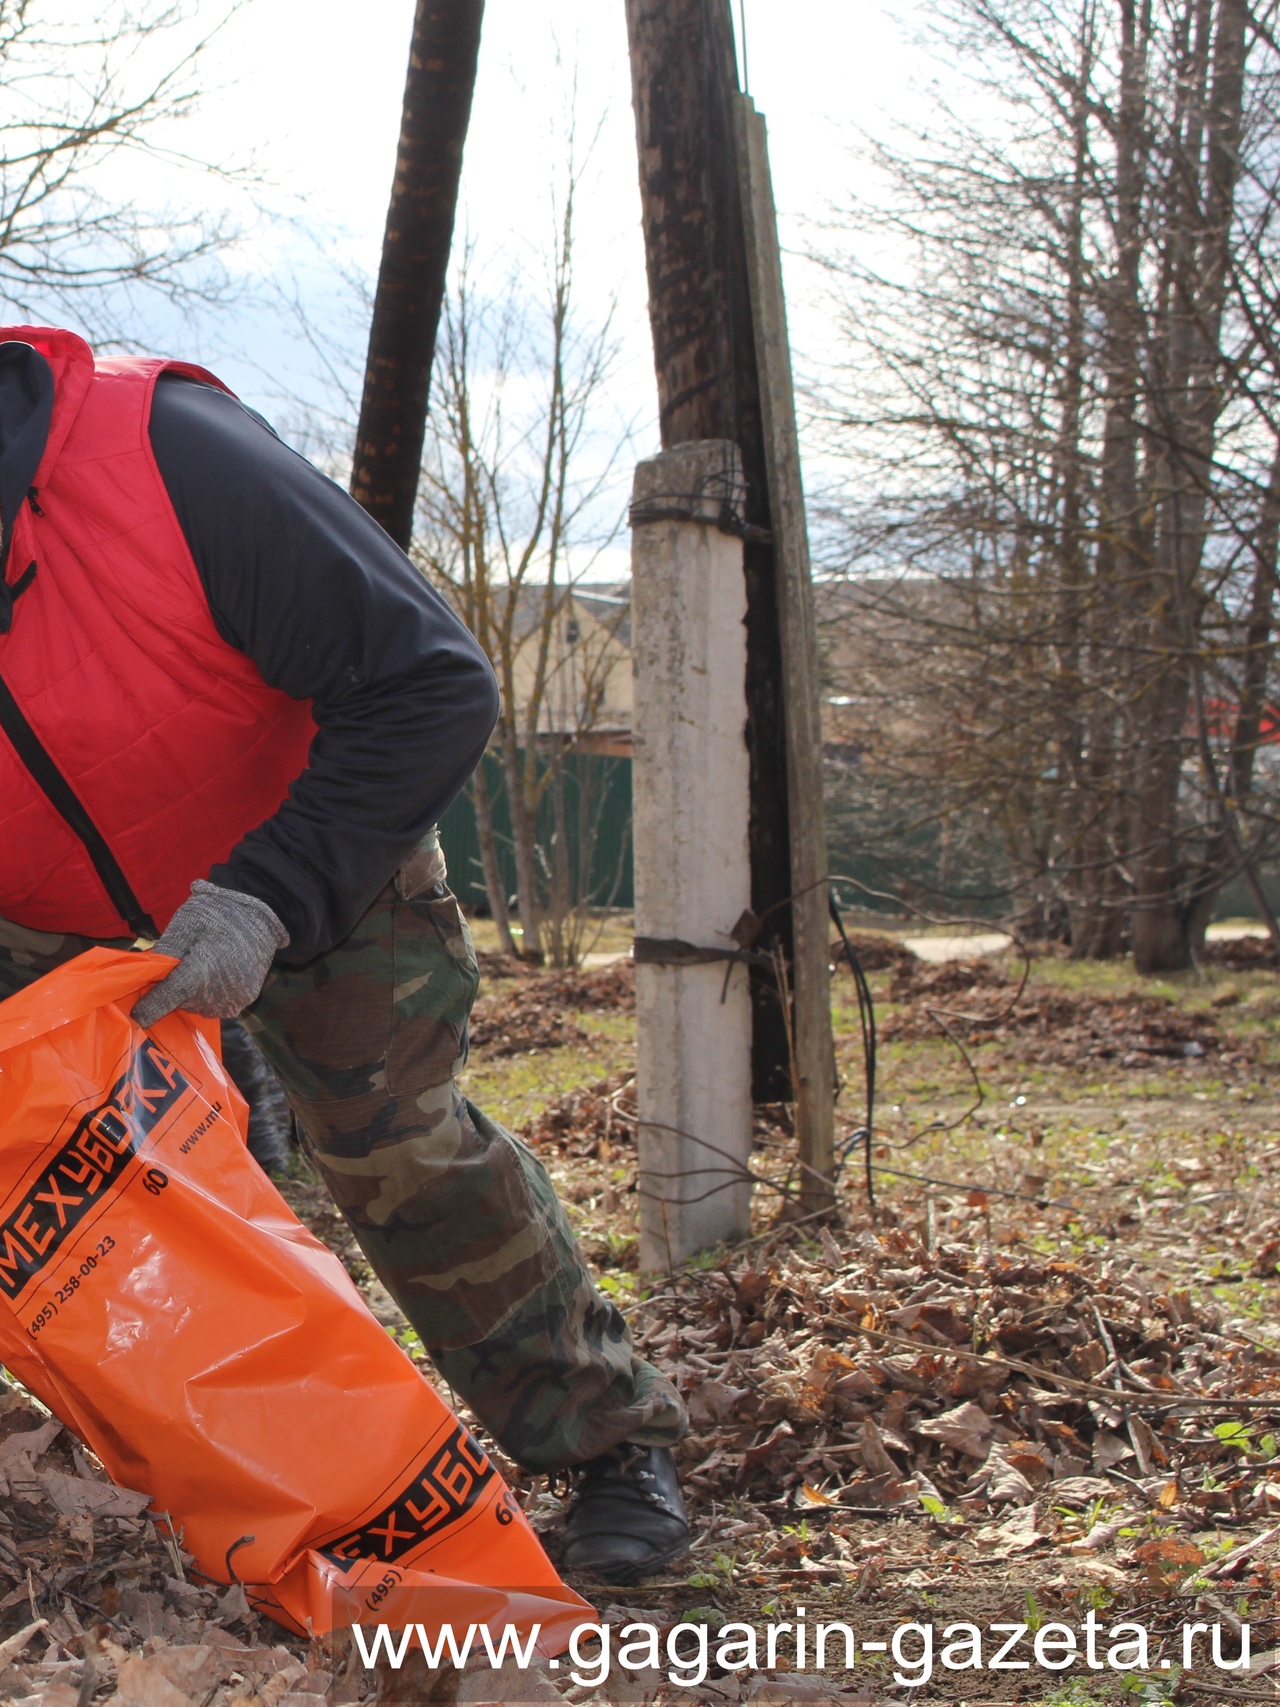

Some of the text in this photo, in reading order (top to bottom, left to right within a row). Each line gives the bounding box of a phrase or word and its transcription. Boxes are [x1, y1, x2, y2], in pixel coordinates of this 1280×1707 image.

[142, 1168, 169, 1196] 60
[26, 1235, 116, 1340] (495) 258-00-23
[365, 1569, 403, 1613] (495)
